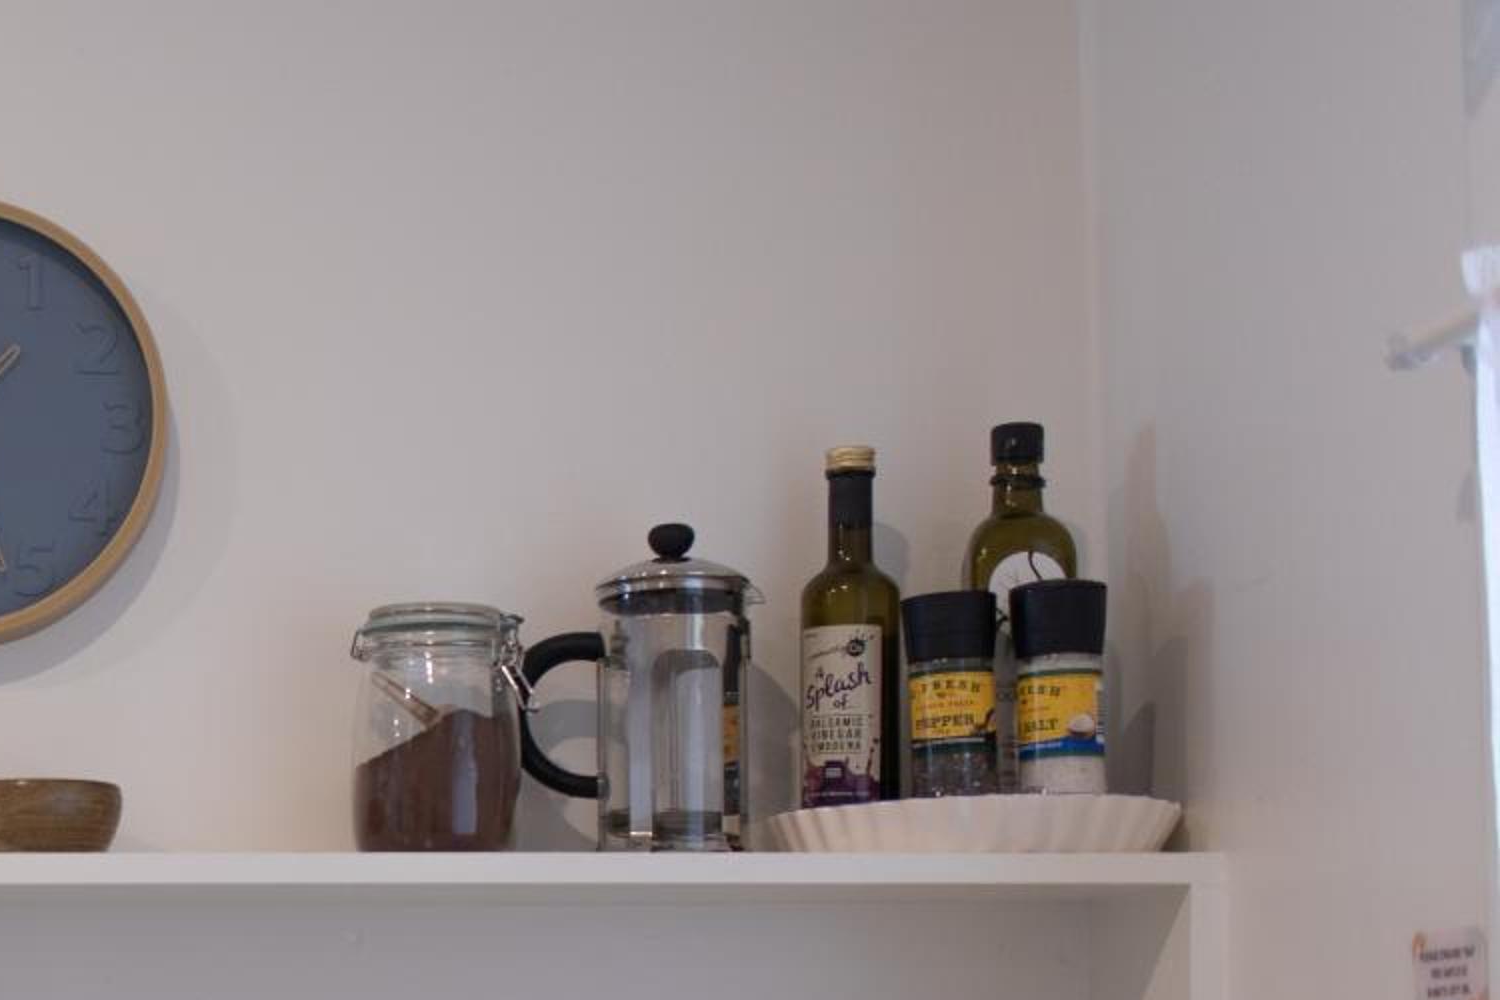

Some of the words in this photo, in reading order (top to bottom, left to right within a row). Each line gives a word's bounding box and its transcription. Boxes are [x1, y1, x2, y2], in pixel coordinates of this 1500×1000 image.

[19, 253, 45, 310] 1
[74, 321, 120, 375] 2
[102, 401, 145, 454] 3
[68, 486, 115, 537] 4
[14, 544, 56, 597] 5
[806, 661, 872, 711] Splash
[915, 714, 975, 730] PEPPER
